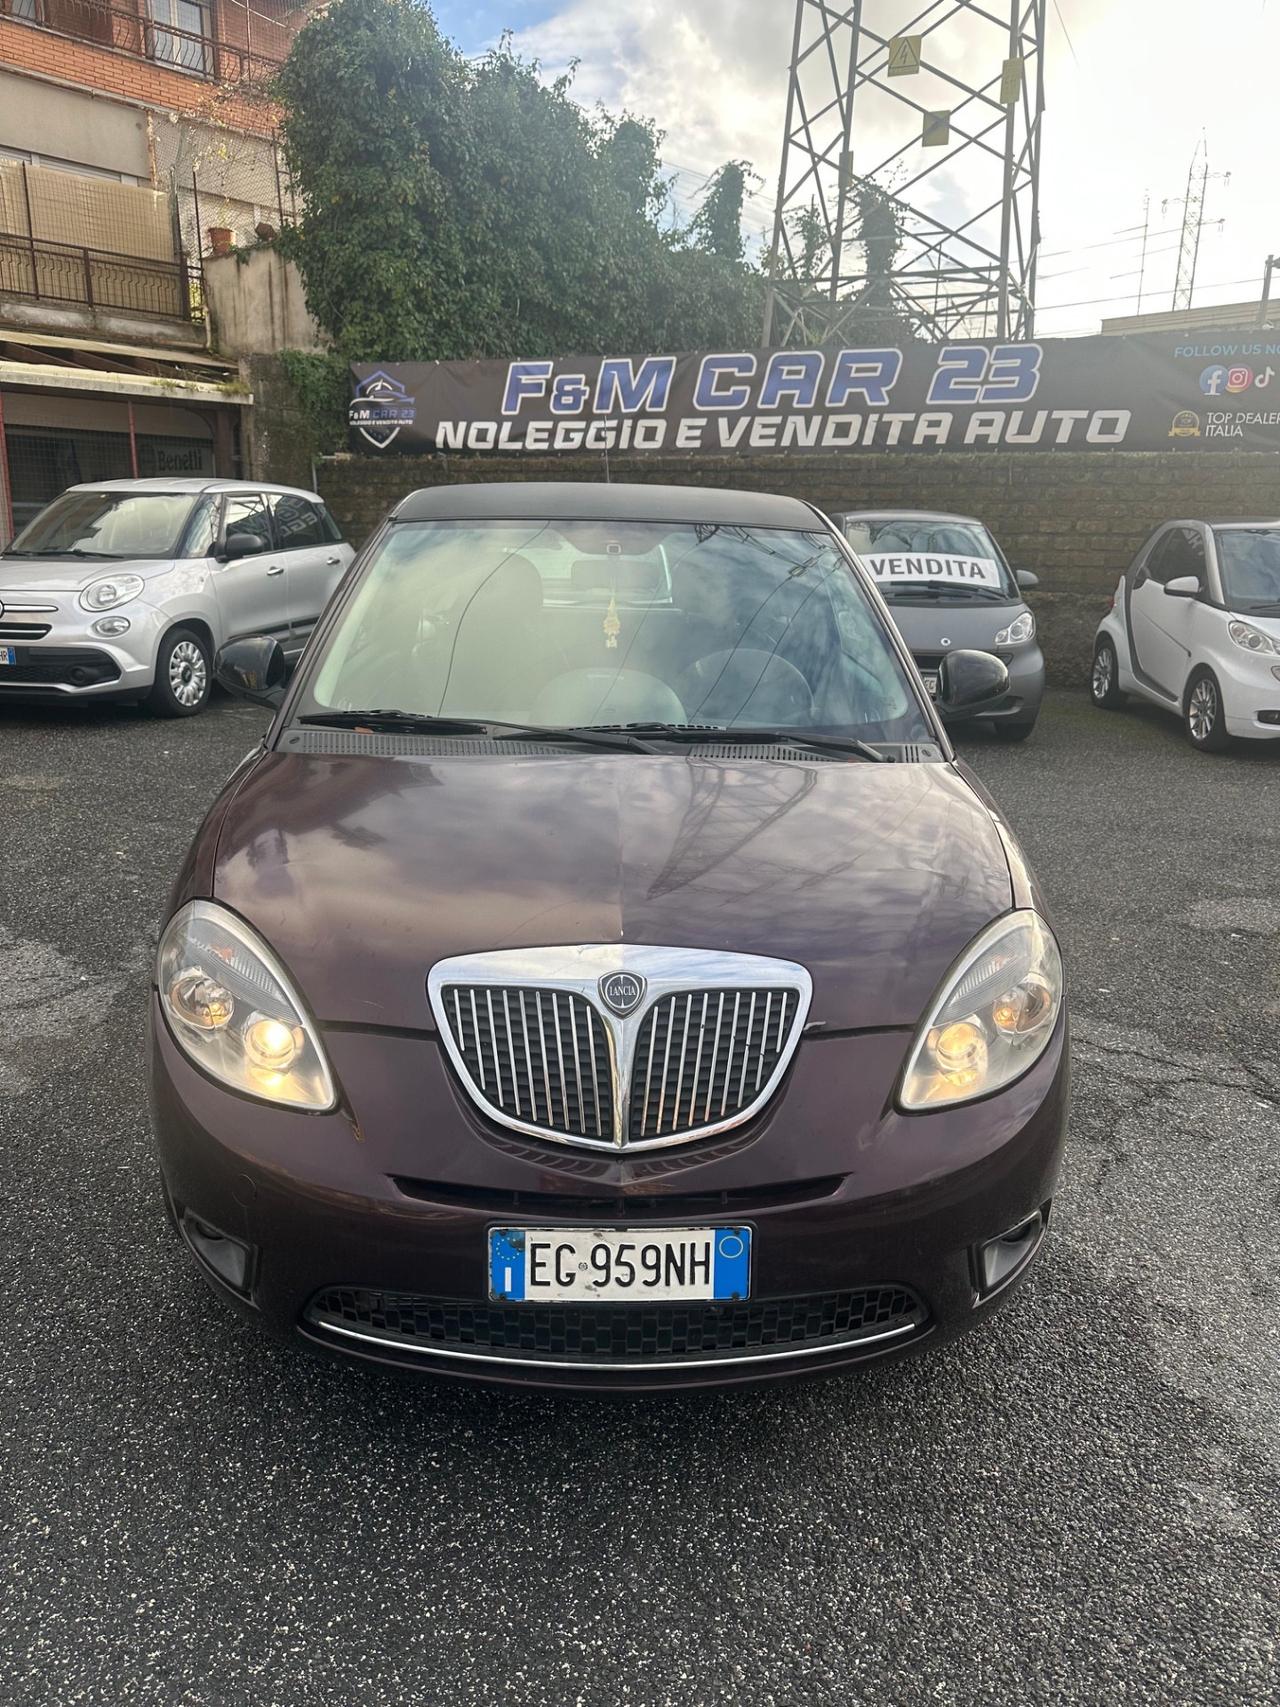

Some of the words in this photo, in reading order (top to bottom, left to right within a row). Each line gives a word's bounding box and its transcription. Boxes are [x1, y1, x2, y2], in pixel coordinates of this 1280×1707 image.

[1173, 345, 1238, 359] FOLLOW
[1242, 344, 1262, 355] US
[501, 356, 677, 415] F&M
[692, 348, 903, 411] CAR
[925, 343, 1044, 405] 23
[372, 409, 398, 419] CAR
[400, 408, 416, 418] 23
[1206, 412, 1233, 424] TOP
[435, 418, 668, 451] NOLEGGIO
[675, 417, 708, 449] E
[717, 412, 954, 448] VENDITA
[963, 409, 1132, 444] AUTO
[1205, 425, 1243, 437] ITALIA
[869, 558, 986, 579] VENDITA
[609, 985, 637, 996] LANCIA
